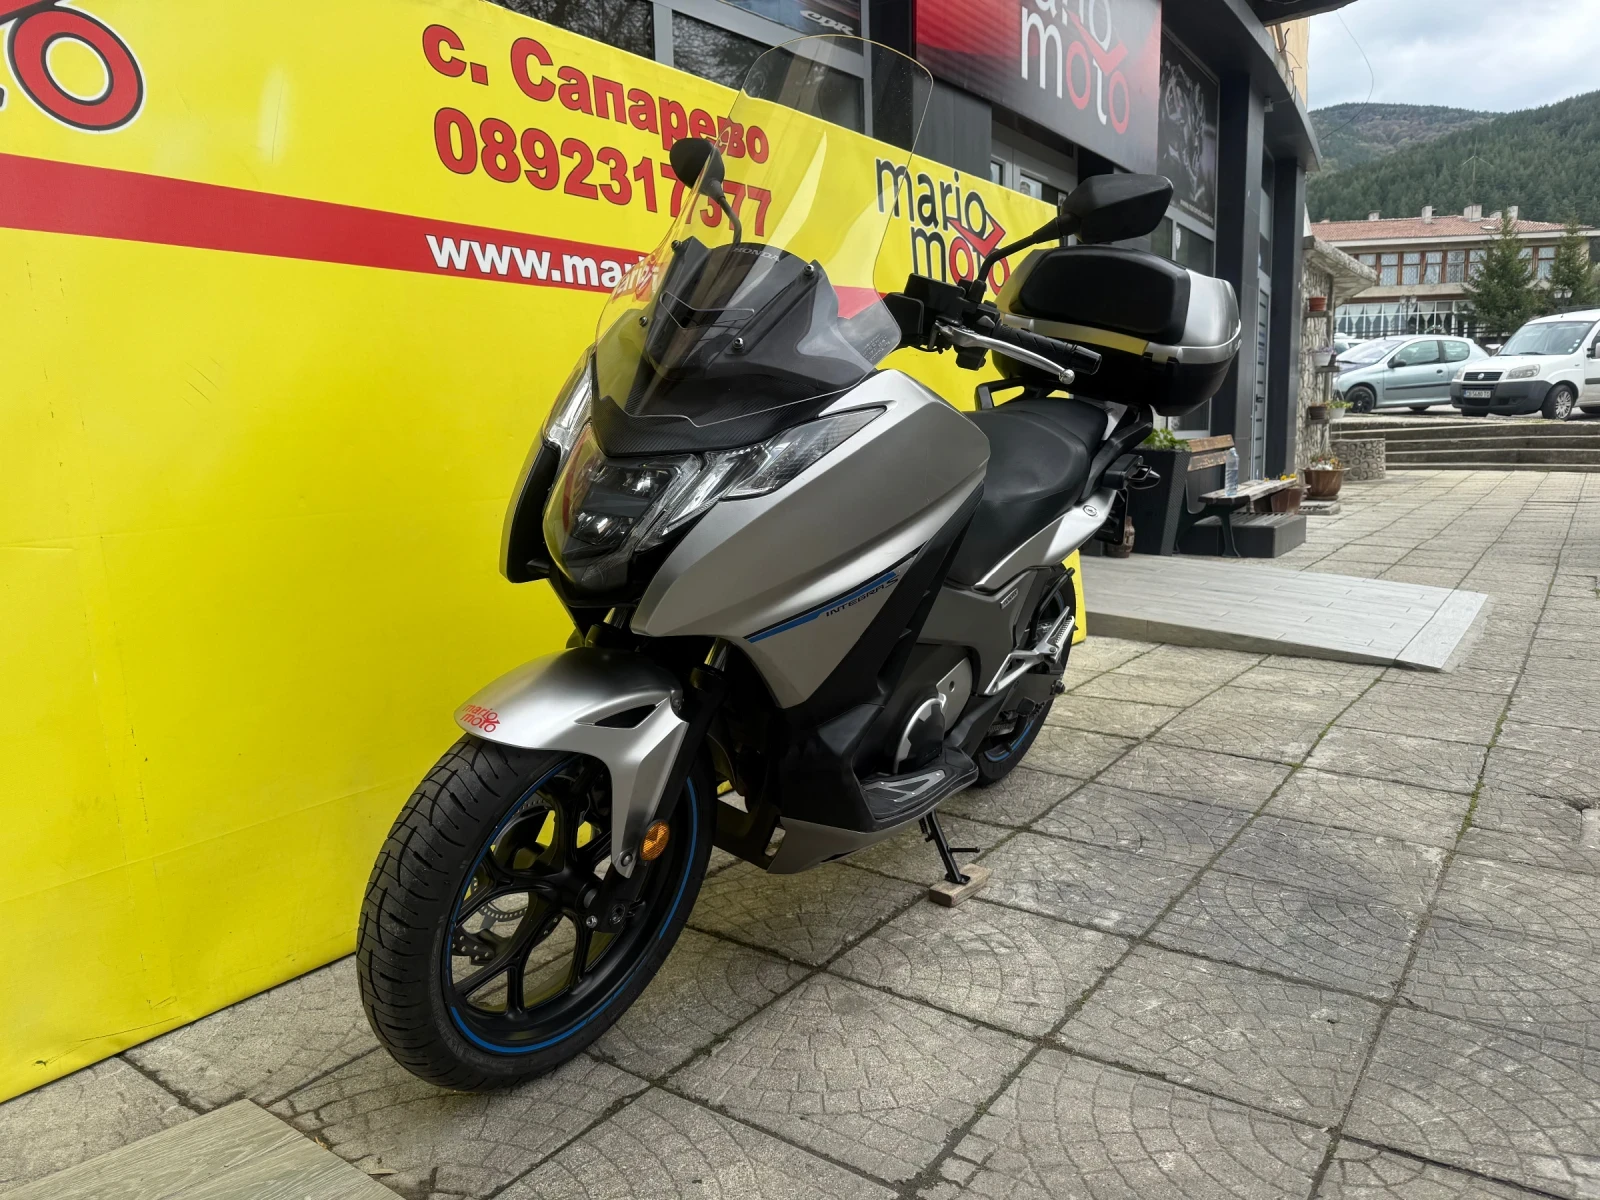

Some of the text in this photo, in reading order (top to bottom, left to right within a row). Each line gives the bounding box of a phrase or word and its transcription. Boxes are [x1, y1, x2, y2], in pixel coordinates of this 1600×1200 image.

[1021, 6, 1130, 135] moto
[510, 37, 770, 165] Сапарево
[875, 158, 990, 239] mario
[734, 247, 780, 262] HONDA
[826, 584, 885, 617] INTEGRA
[460, 713, 498, 732] moto
[461, 704, 498, 721] mario
